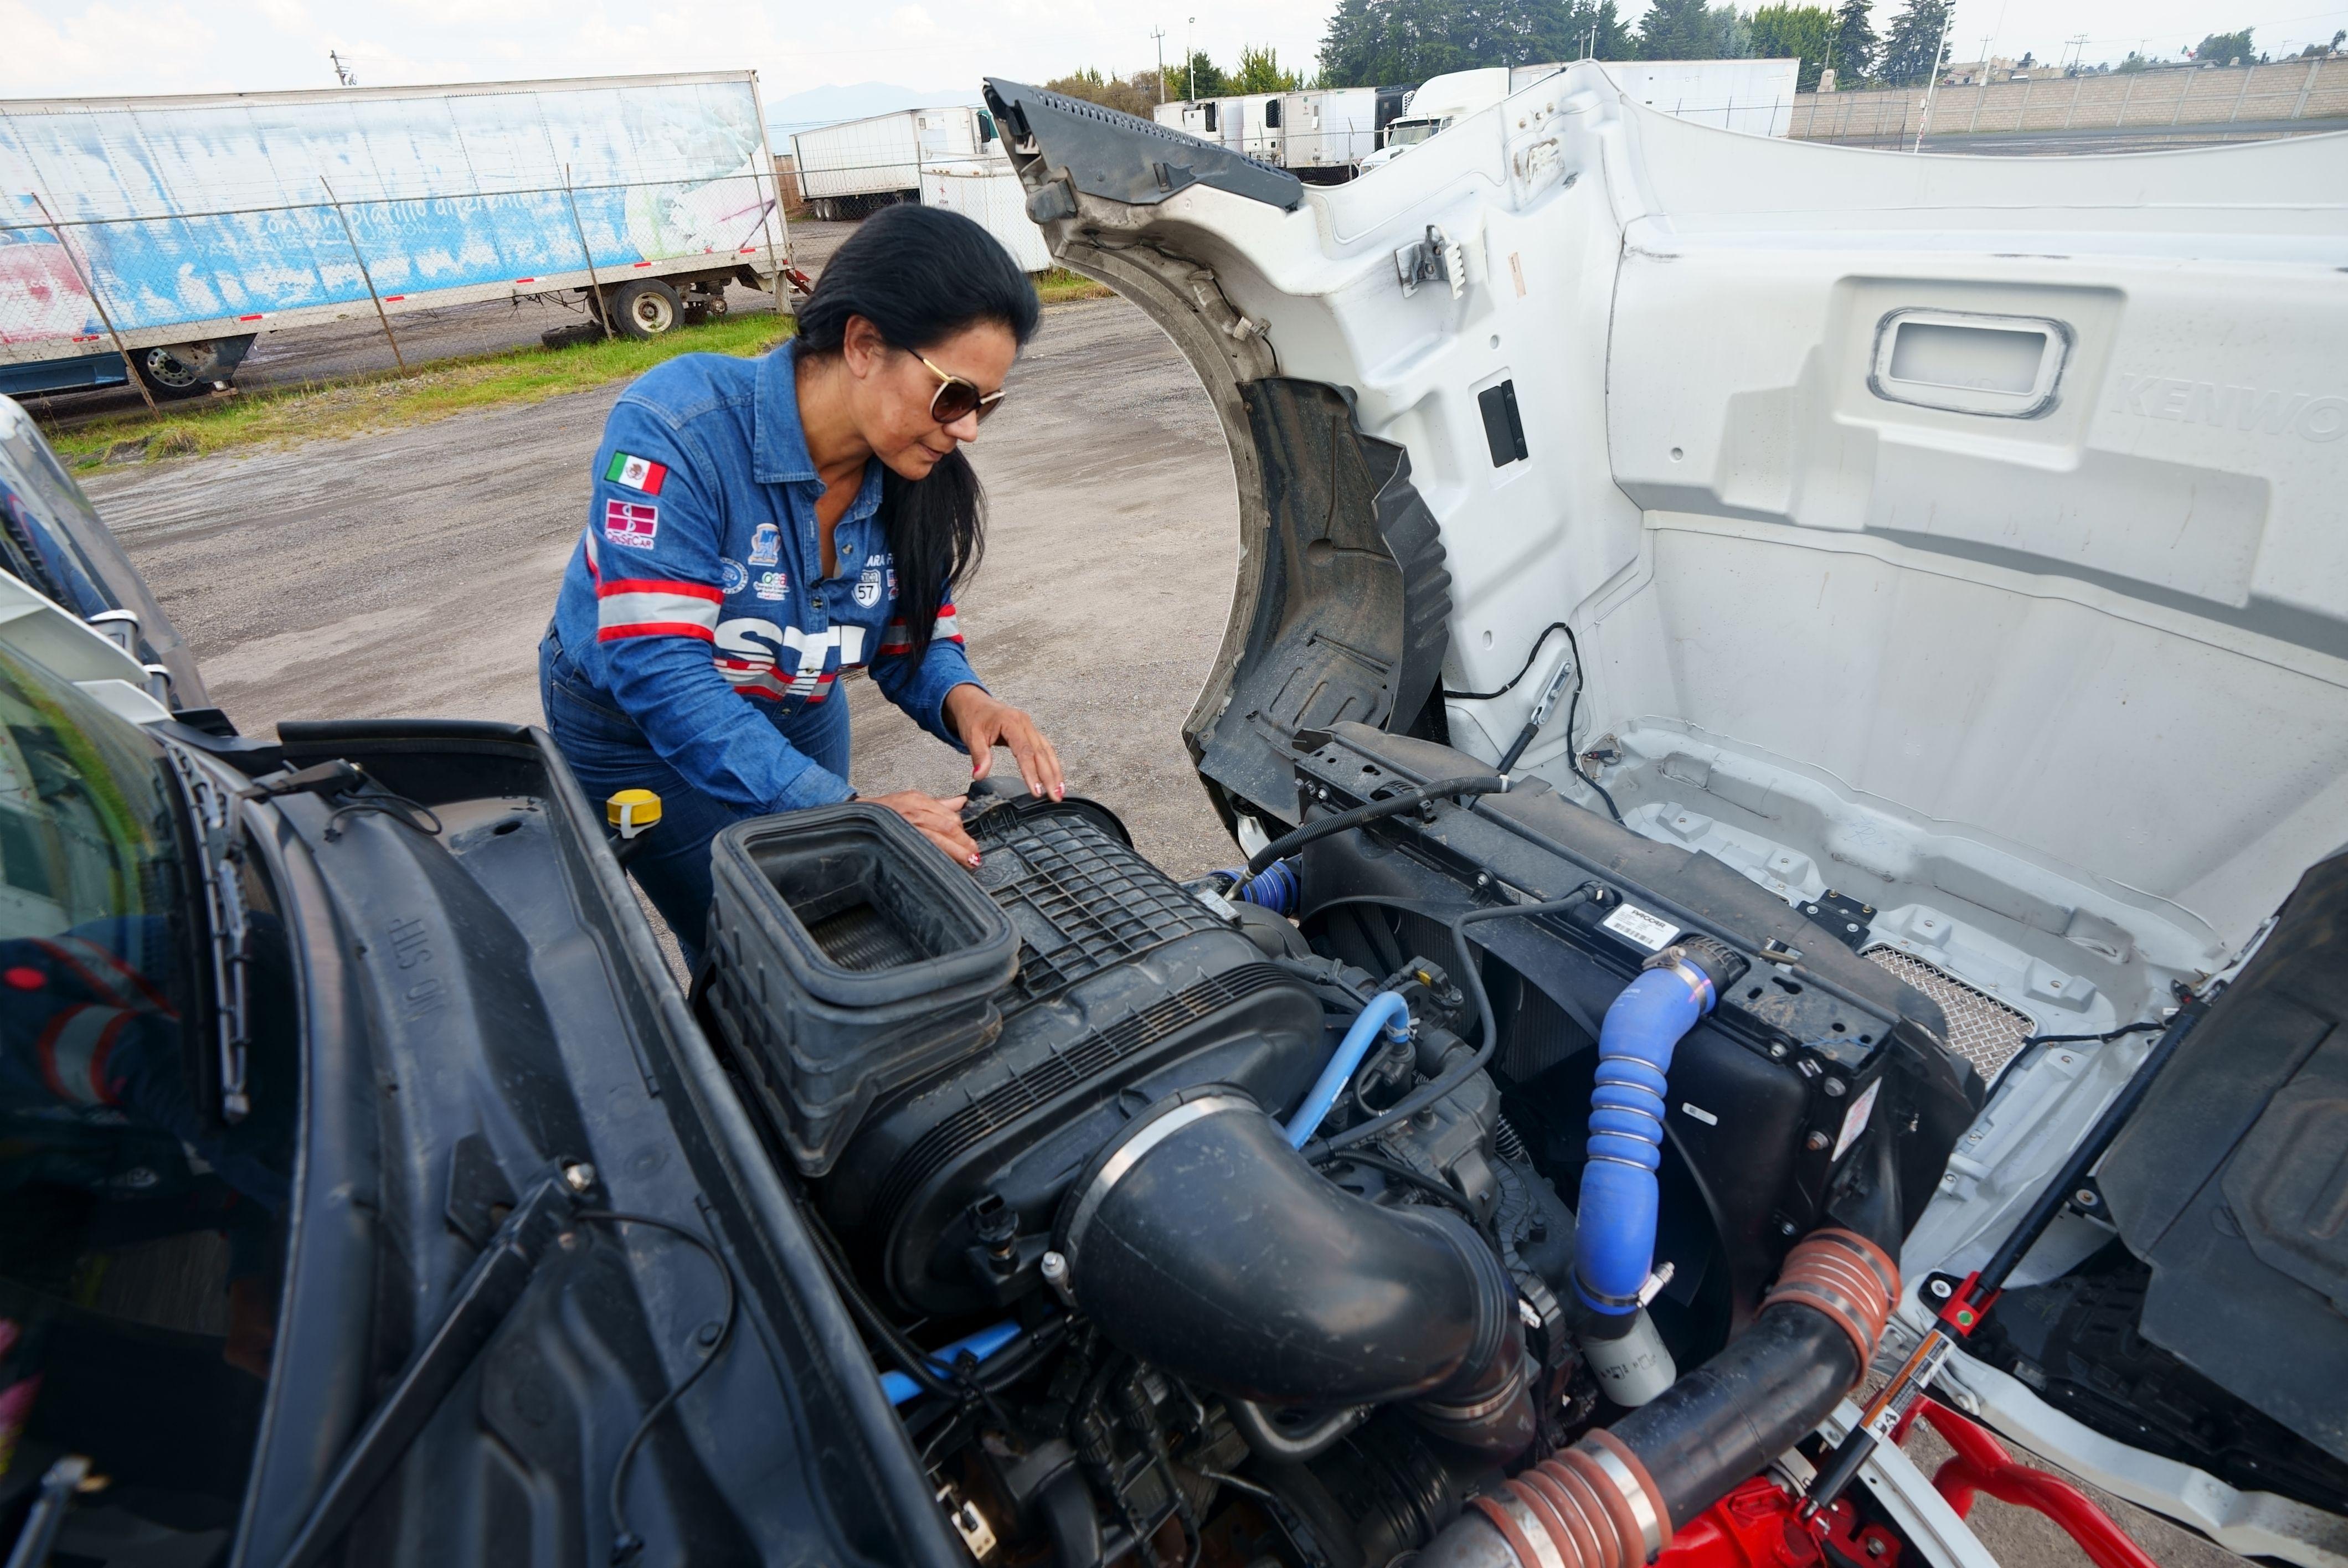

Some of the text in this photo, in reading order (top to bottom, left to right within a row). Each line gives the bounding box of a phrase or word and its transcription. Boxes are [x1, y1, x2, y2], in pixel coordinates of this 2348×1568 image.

[864, 554, 885, 567] ARA
[858, 585, 874, 600] 57
[1630, 909, 1666, 929] PACCAR
